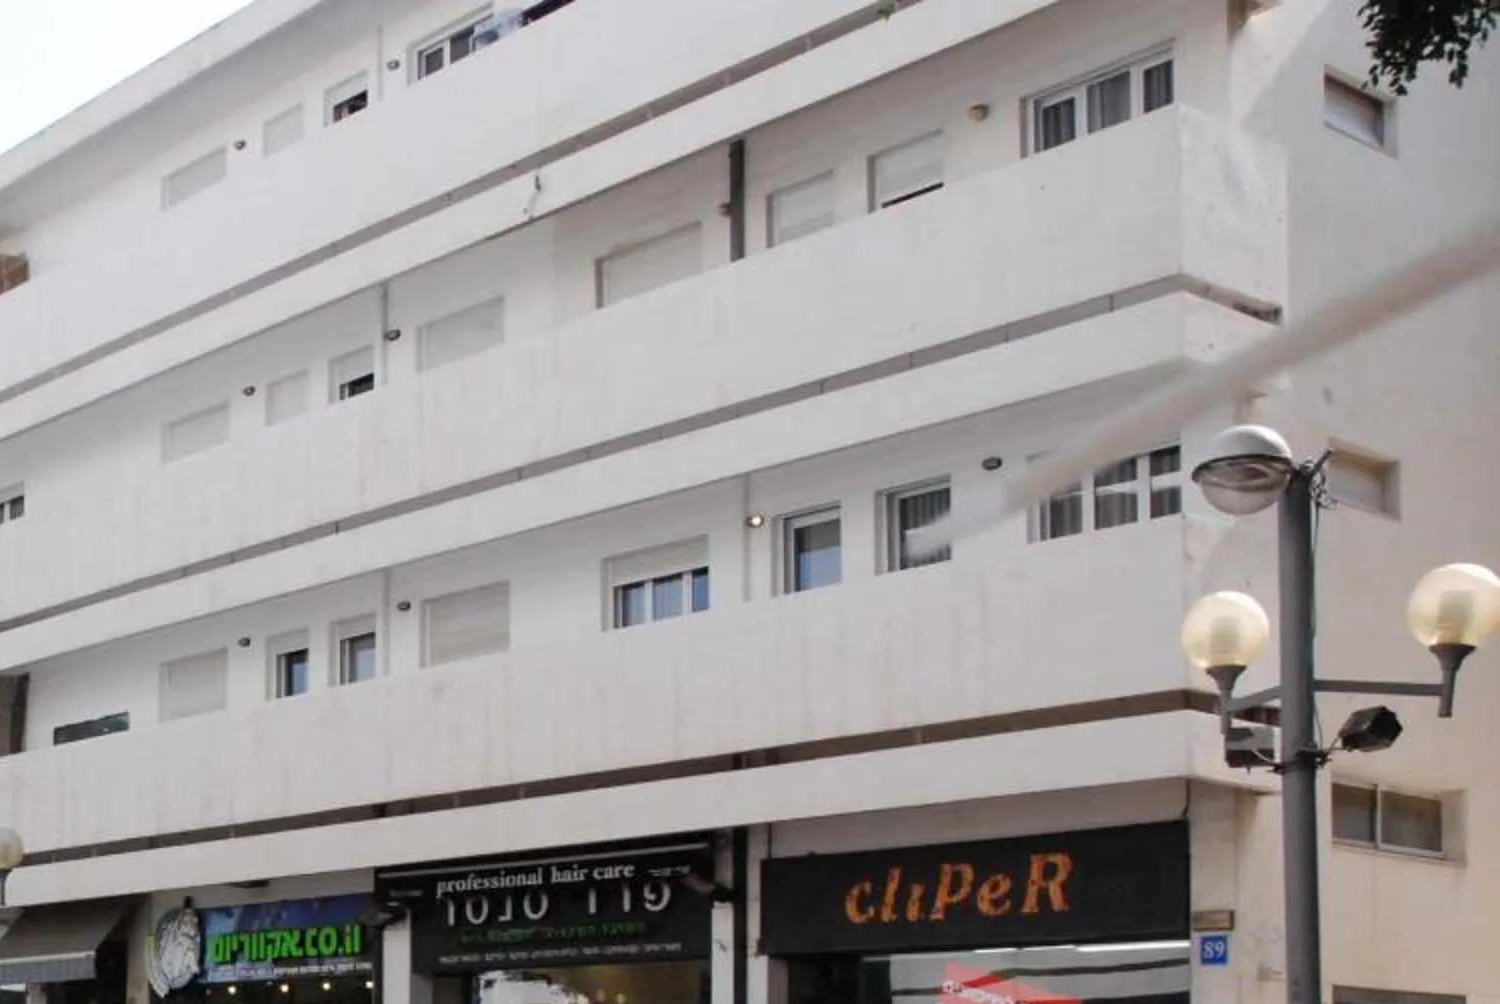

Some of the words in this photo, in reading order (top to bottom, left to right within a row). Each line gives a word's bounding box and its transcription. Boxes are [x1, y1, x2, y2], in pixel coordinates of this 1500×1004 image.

[437, 867, 543, 898] professional
[551, 866, 588, 885] hair
[593, 863, 636, 880] care
[1203, 940, 1225, 959] 89
